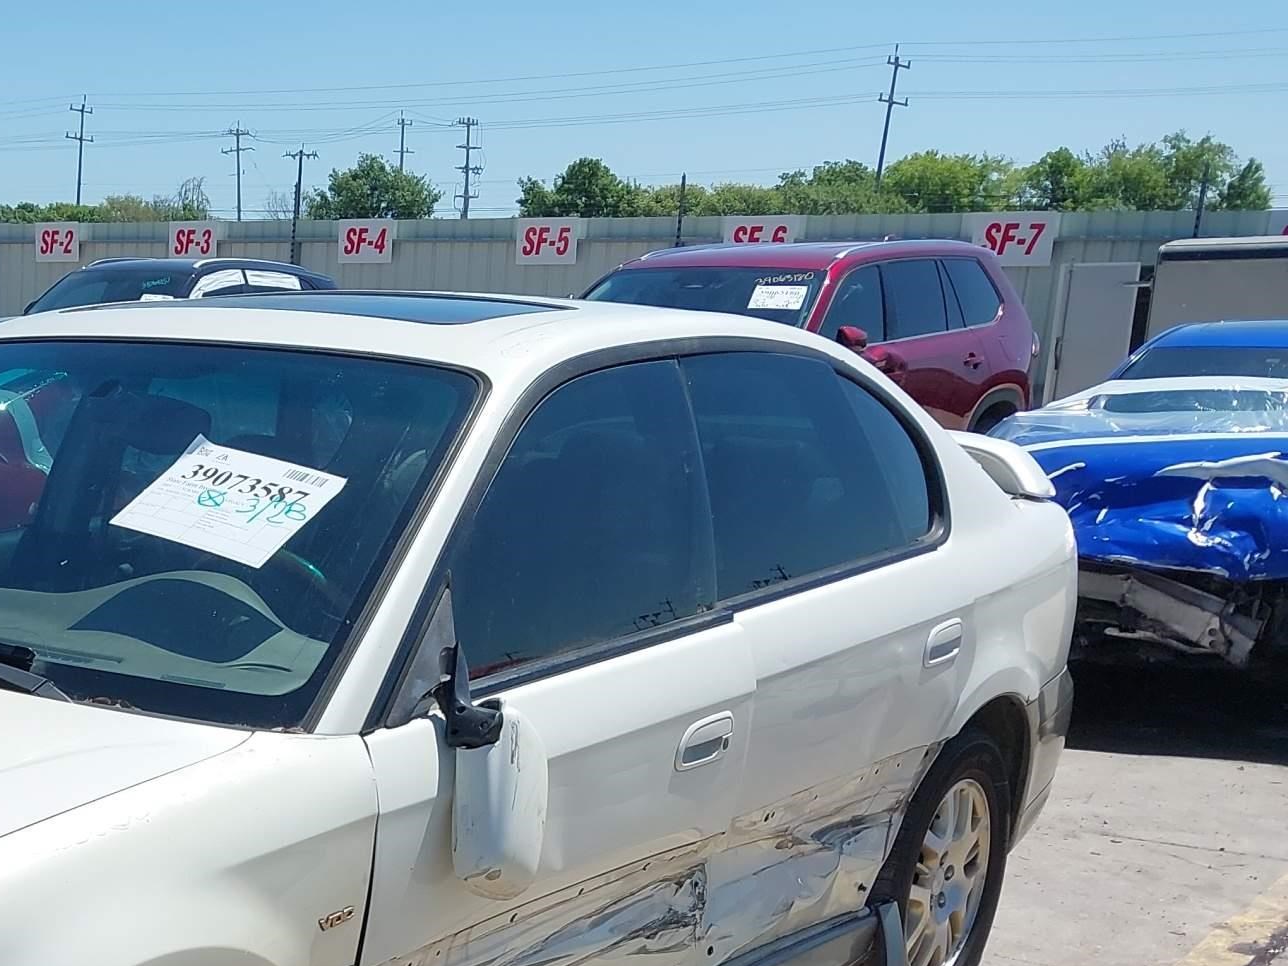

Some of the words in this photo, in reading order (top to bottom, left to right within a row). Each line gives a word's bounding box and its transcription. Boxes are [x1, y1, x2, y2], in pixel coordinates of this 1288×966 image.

[40, 230, 74, 254] SF-2
[174, 229, 212, 255] SF-3
[343, 227, 388, 255] SF-4
[522, 227, 571, 256] SF-5
[733, 225, 788, 243] SF6
[984, 222, 1046, 256] SF-7
[180, 464, 311, 508] 39073587
[318, 905, 355, 931] VDC
